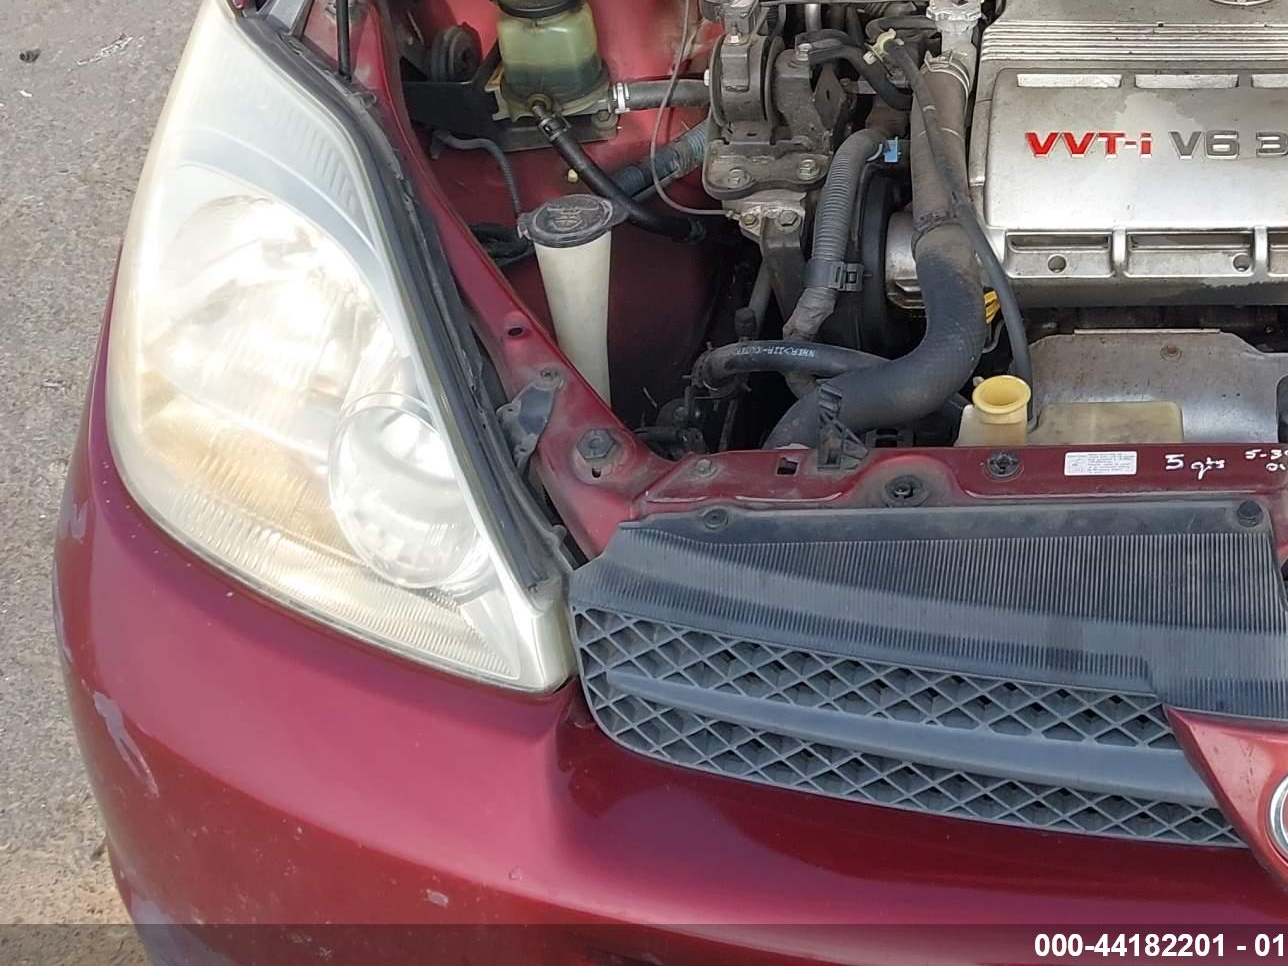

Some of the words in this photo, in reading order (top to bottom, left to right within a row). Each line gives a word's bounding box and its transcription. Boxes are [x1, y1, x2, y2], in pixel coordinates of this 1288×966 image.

[1025, 131, 1153, 159] VVT-i
[1169, 130, 1241, 160] V6
[1164, 453, 1185, 471] 5
[1190, 456, 1226, 481] qts
